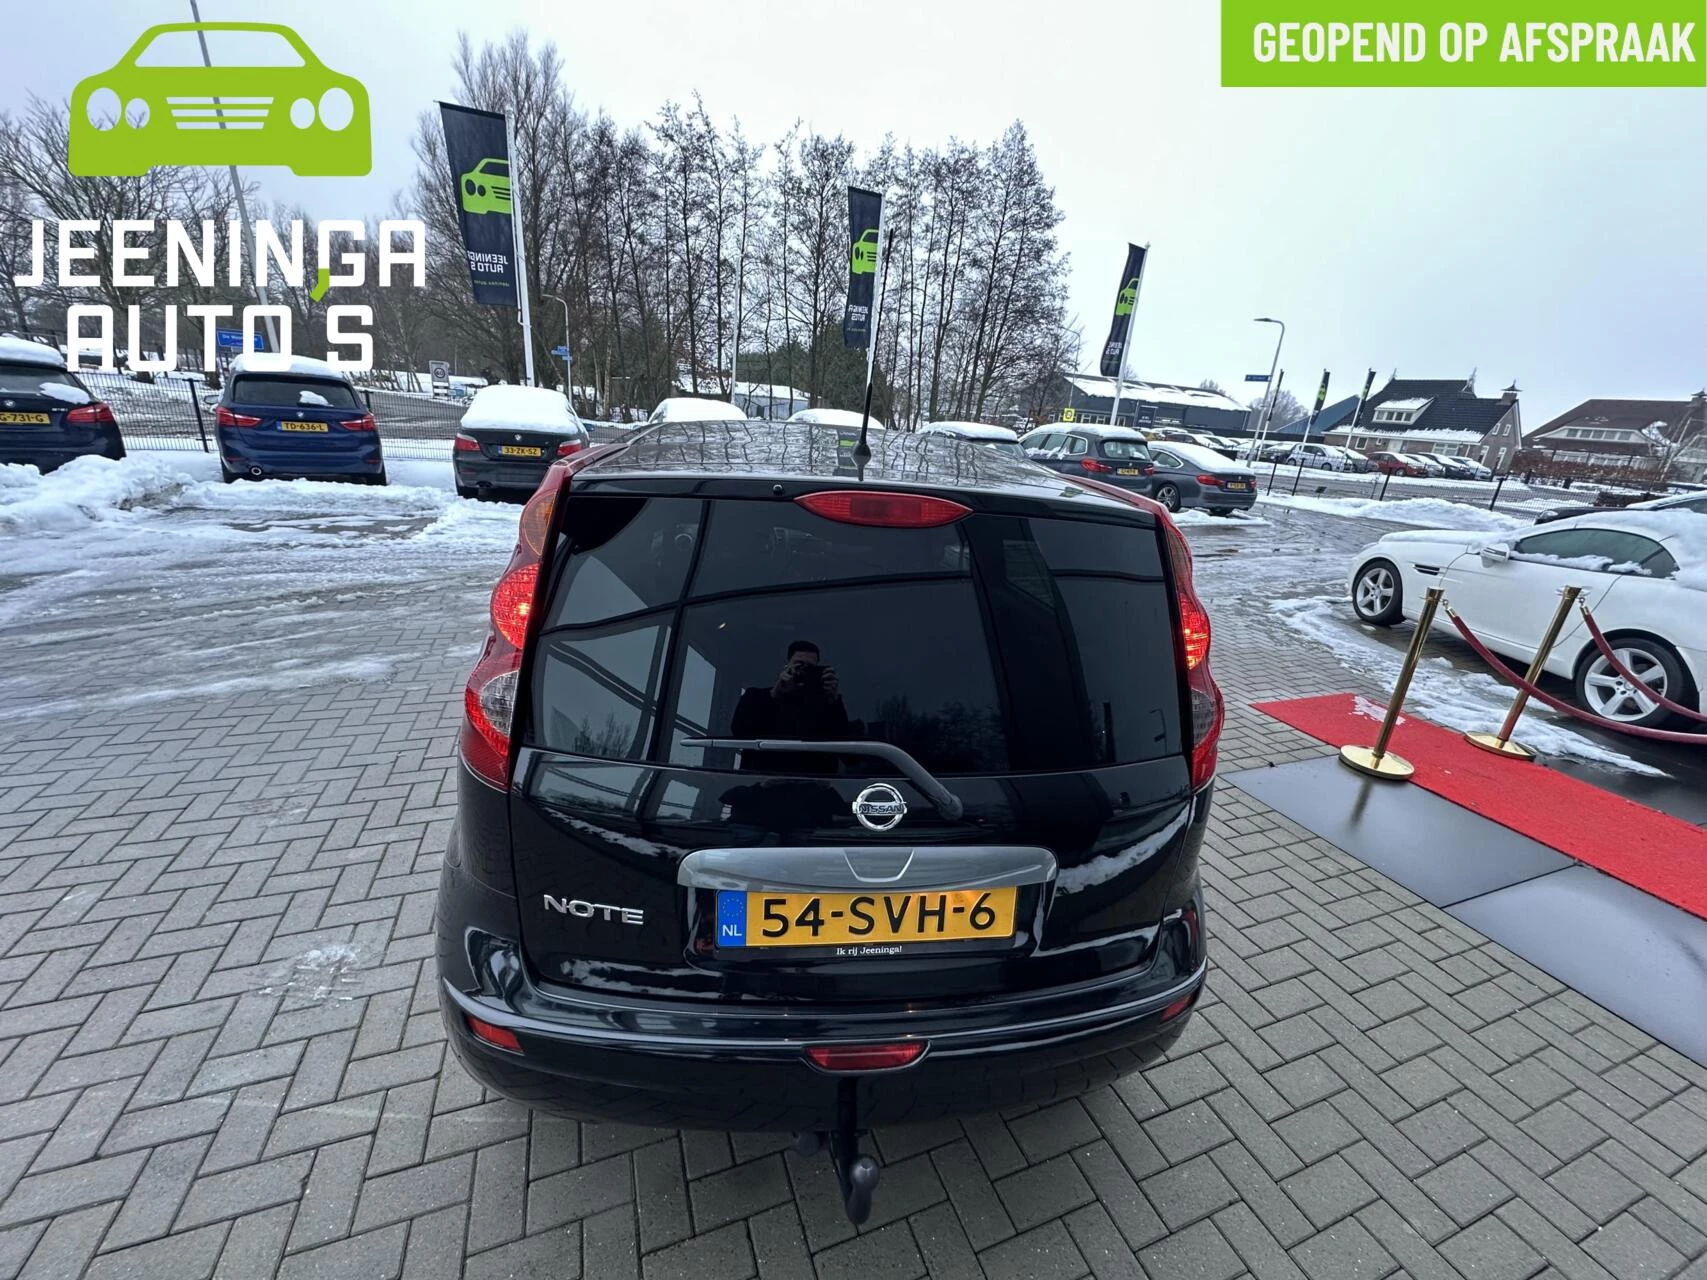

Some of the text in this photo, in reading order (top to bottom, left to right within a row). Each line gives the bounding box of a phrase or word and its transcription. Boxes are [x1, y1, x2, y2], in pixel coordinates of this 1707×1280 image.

[860, 803, 903, 814] NISSAN
[542, 893, 645, 926] NOTE
[761, 891, 997, 938] 54-SVH-6
[721, 924, 743, 938] NL
[836, 945, 903, 956] Ik rij Jeeninga!
